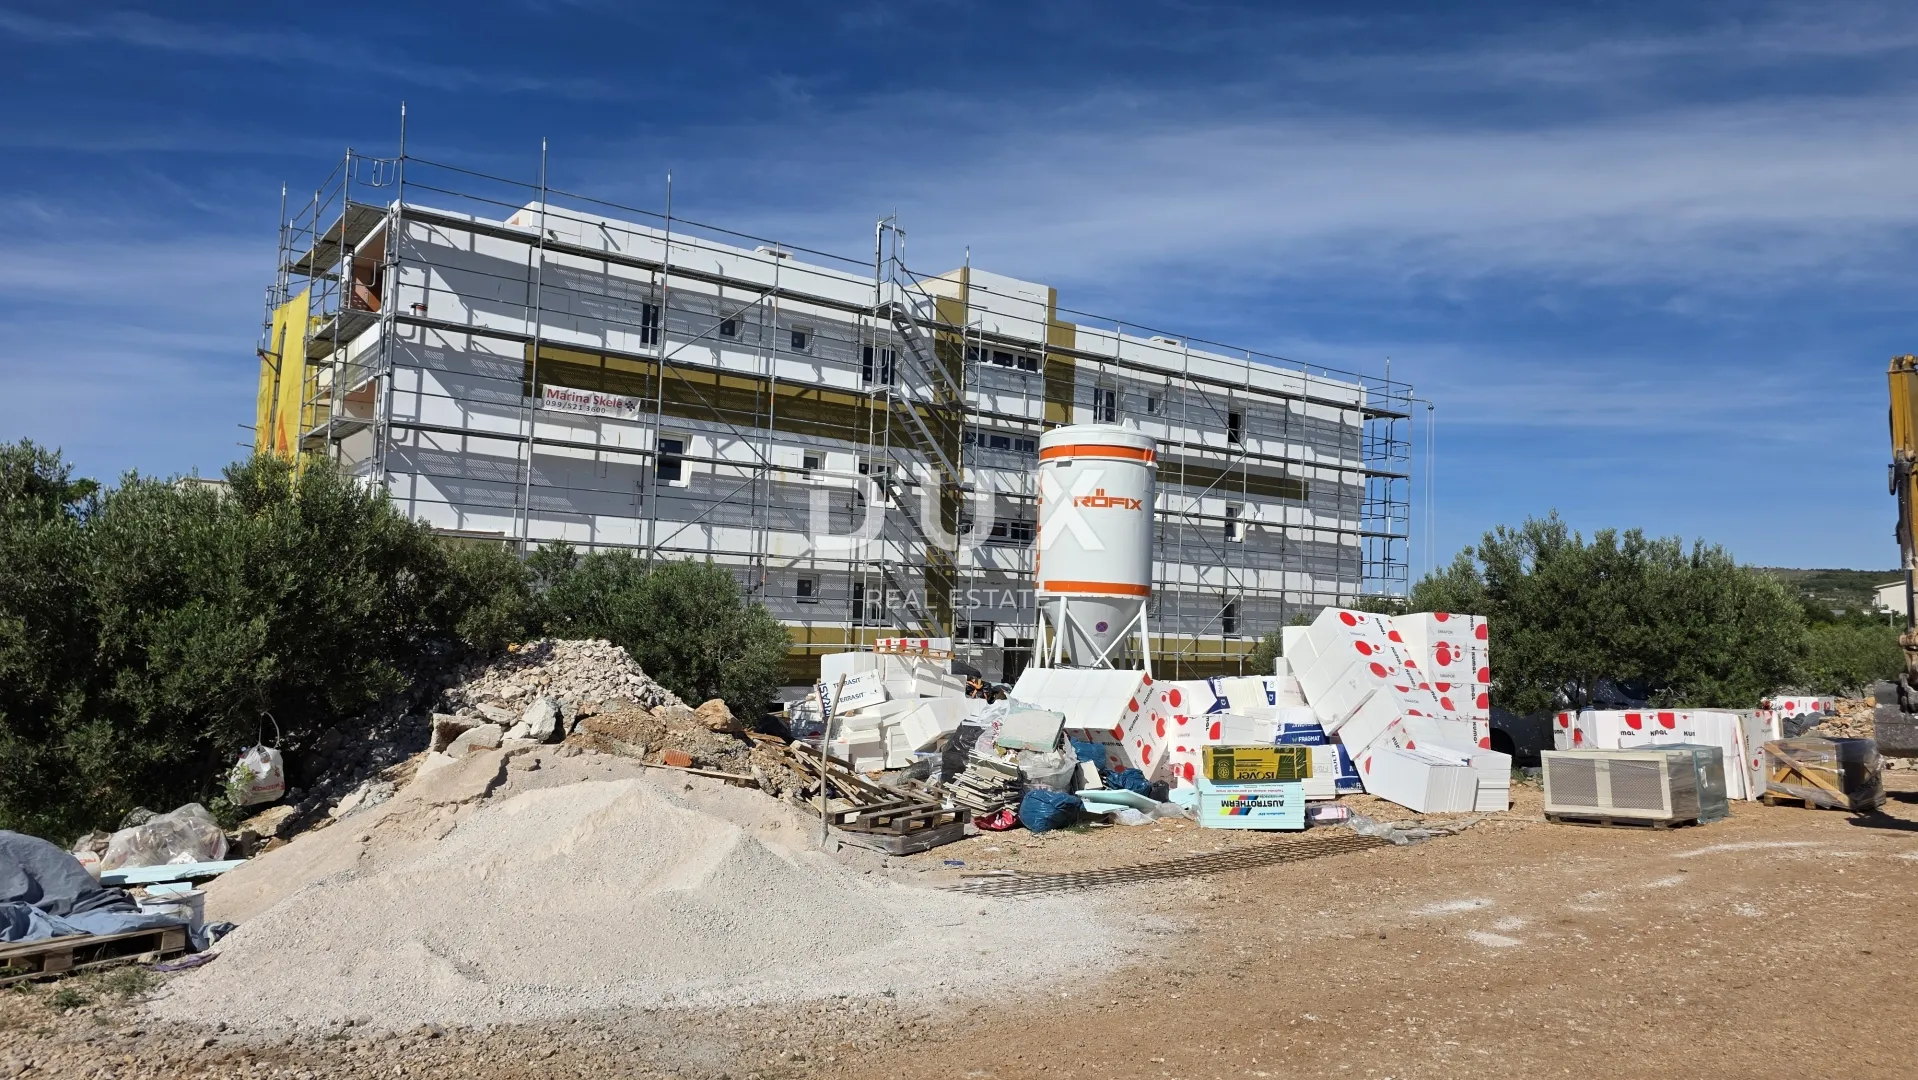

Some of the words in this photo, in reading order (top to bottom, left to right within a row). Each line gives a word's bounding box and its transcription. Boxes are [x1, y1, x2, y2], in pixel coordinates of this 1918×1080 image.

[547, 389, 590, 404] Marina
[593, 395, 623, 409] Skele
[545, 400, 583, 411] 099/521
[1073, 488, 1143, 511] RÖFIX
[840, 692, 864, 703] ERRASIT
[1221, 800, 1284, 808] AUSTROTHERM
